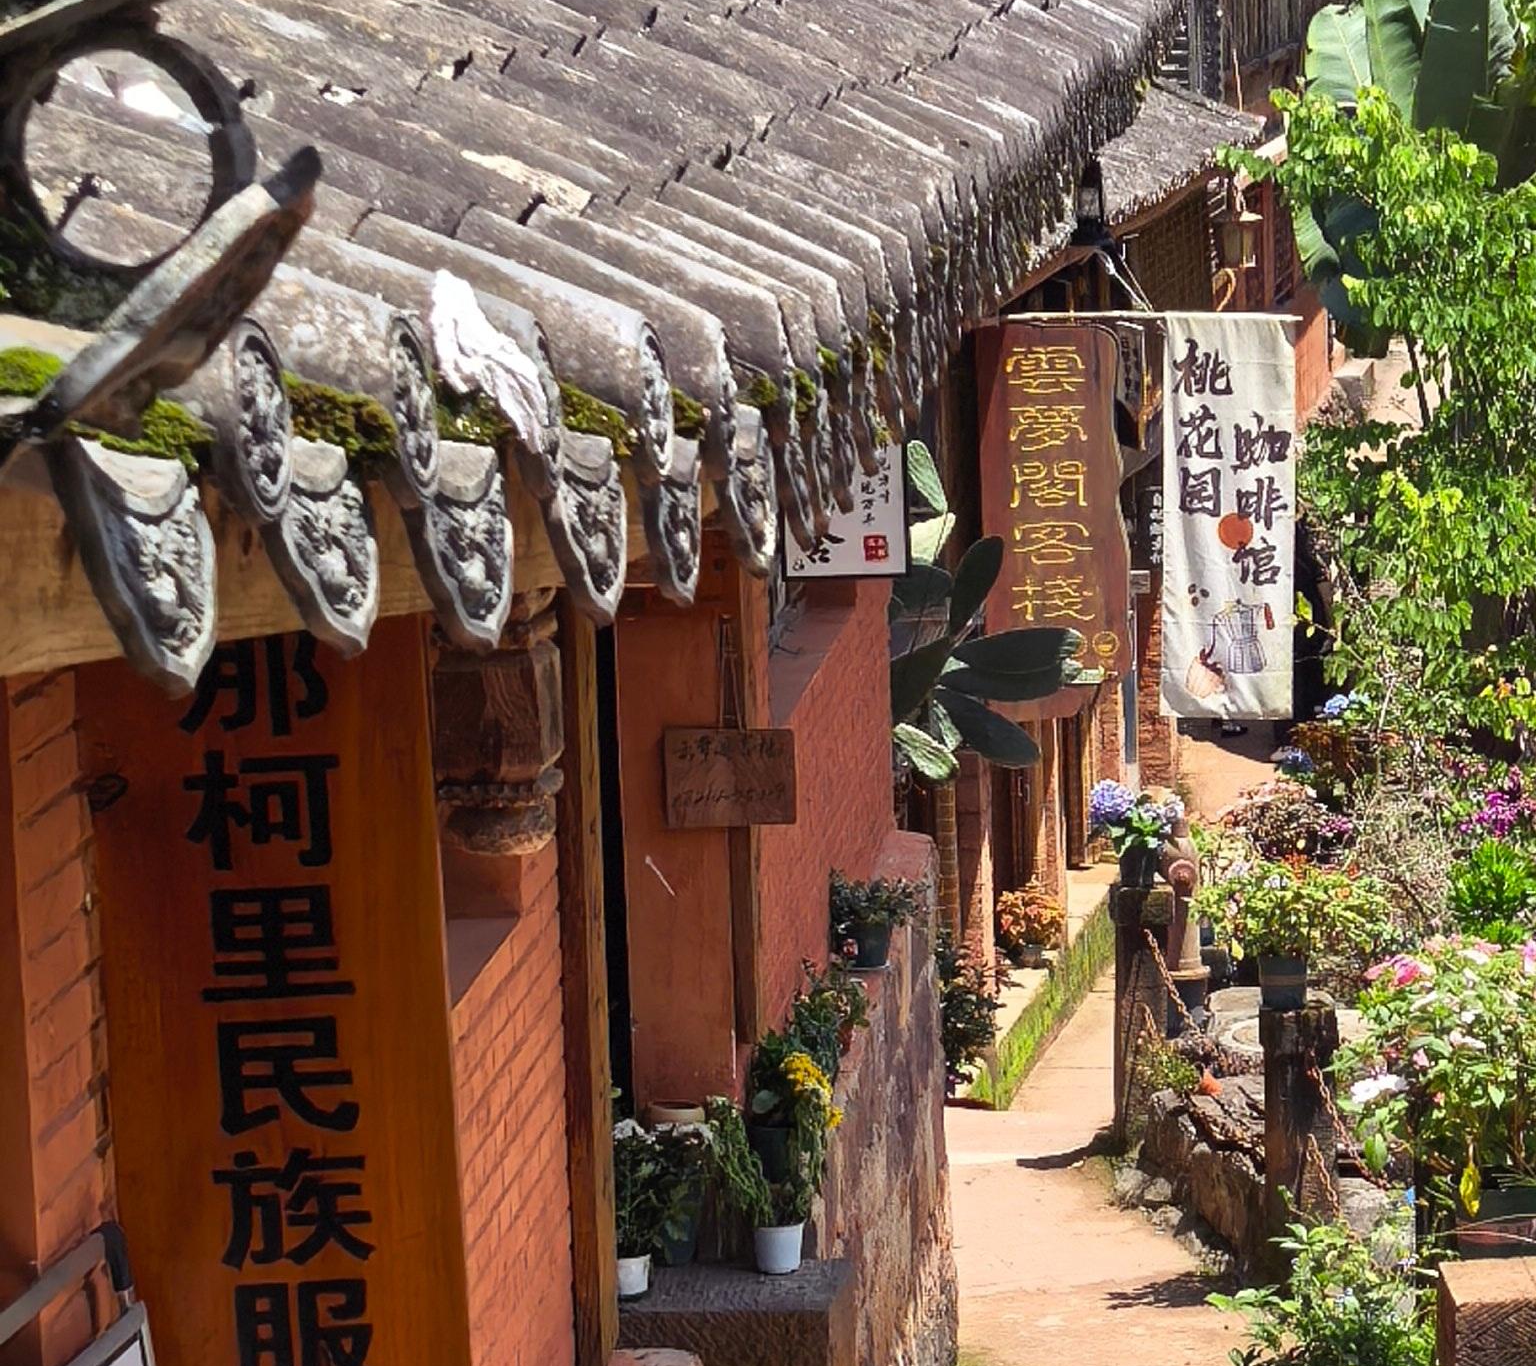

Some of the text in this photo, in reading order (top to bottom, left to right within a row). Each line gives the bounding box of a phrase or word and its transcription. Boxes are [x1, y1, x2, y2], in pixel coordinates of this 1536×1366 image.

[1172, 337, 1233, 517] 桃花园
[1231, 411, 1292, 586] 咖啡馆
